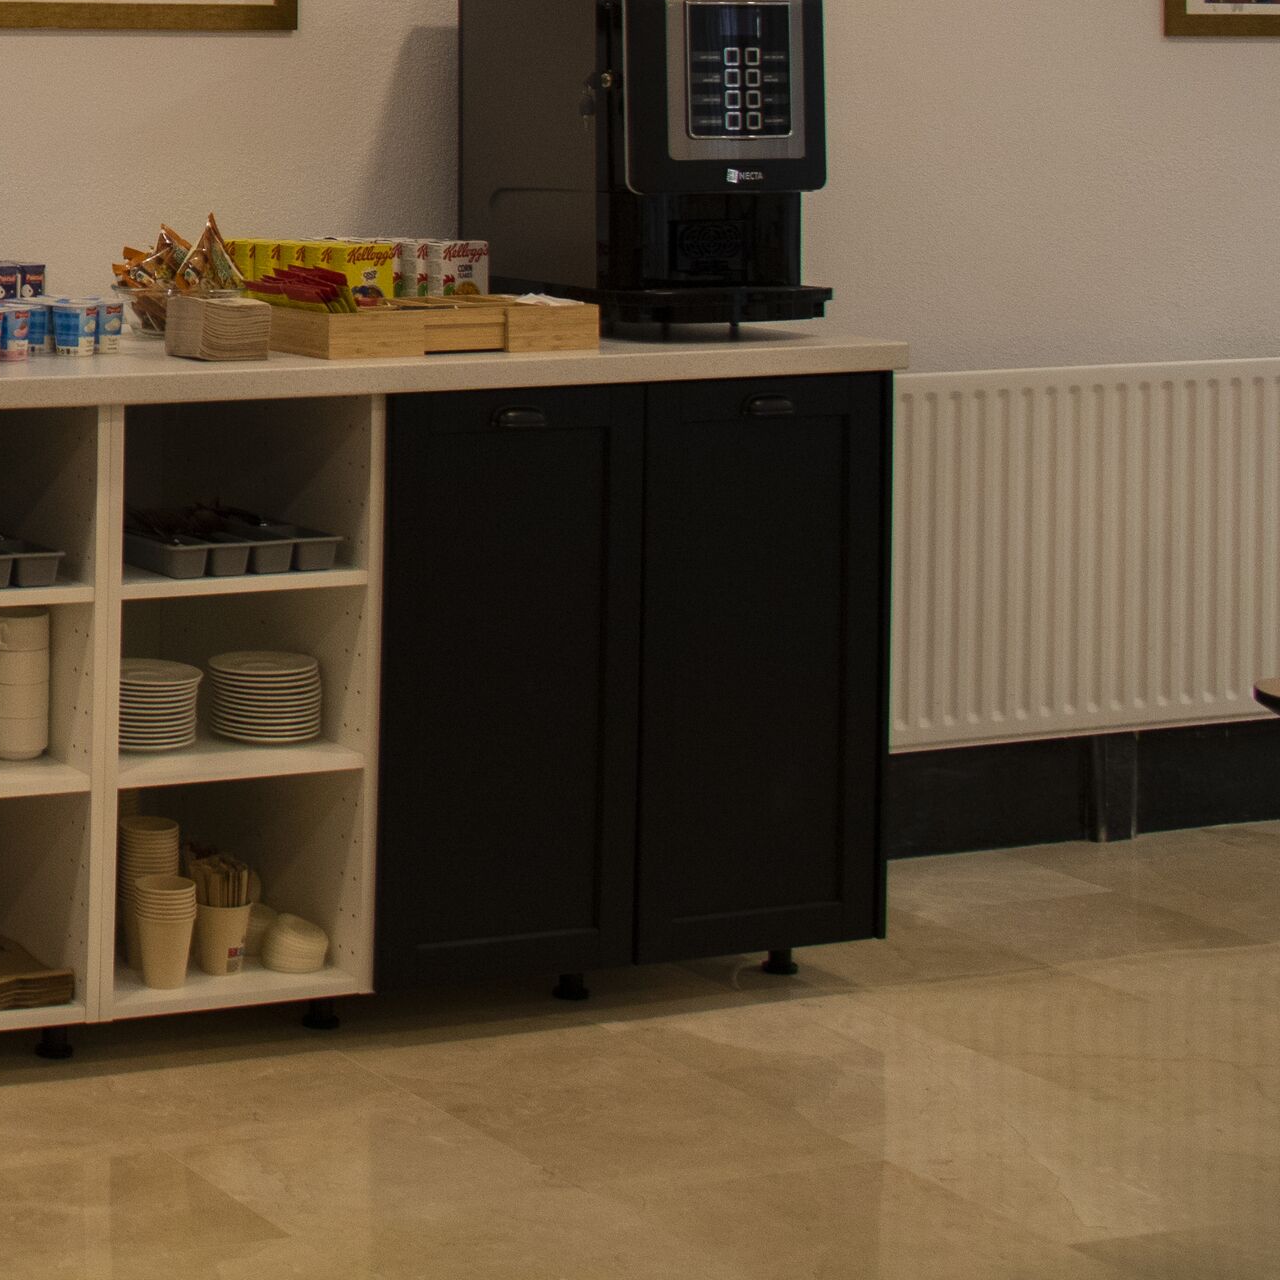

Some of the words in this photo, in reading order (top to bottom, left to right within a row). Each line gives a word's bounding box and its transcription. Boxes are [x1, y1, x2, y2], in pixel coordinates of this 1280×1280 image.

[739, 172, 764, 181] NECTA
[347, 246, 394, 266] Kellogg's
[443, 243, 489, 263] Kellogg's
